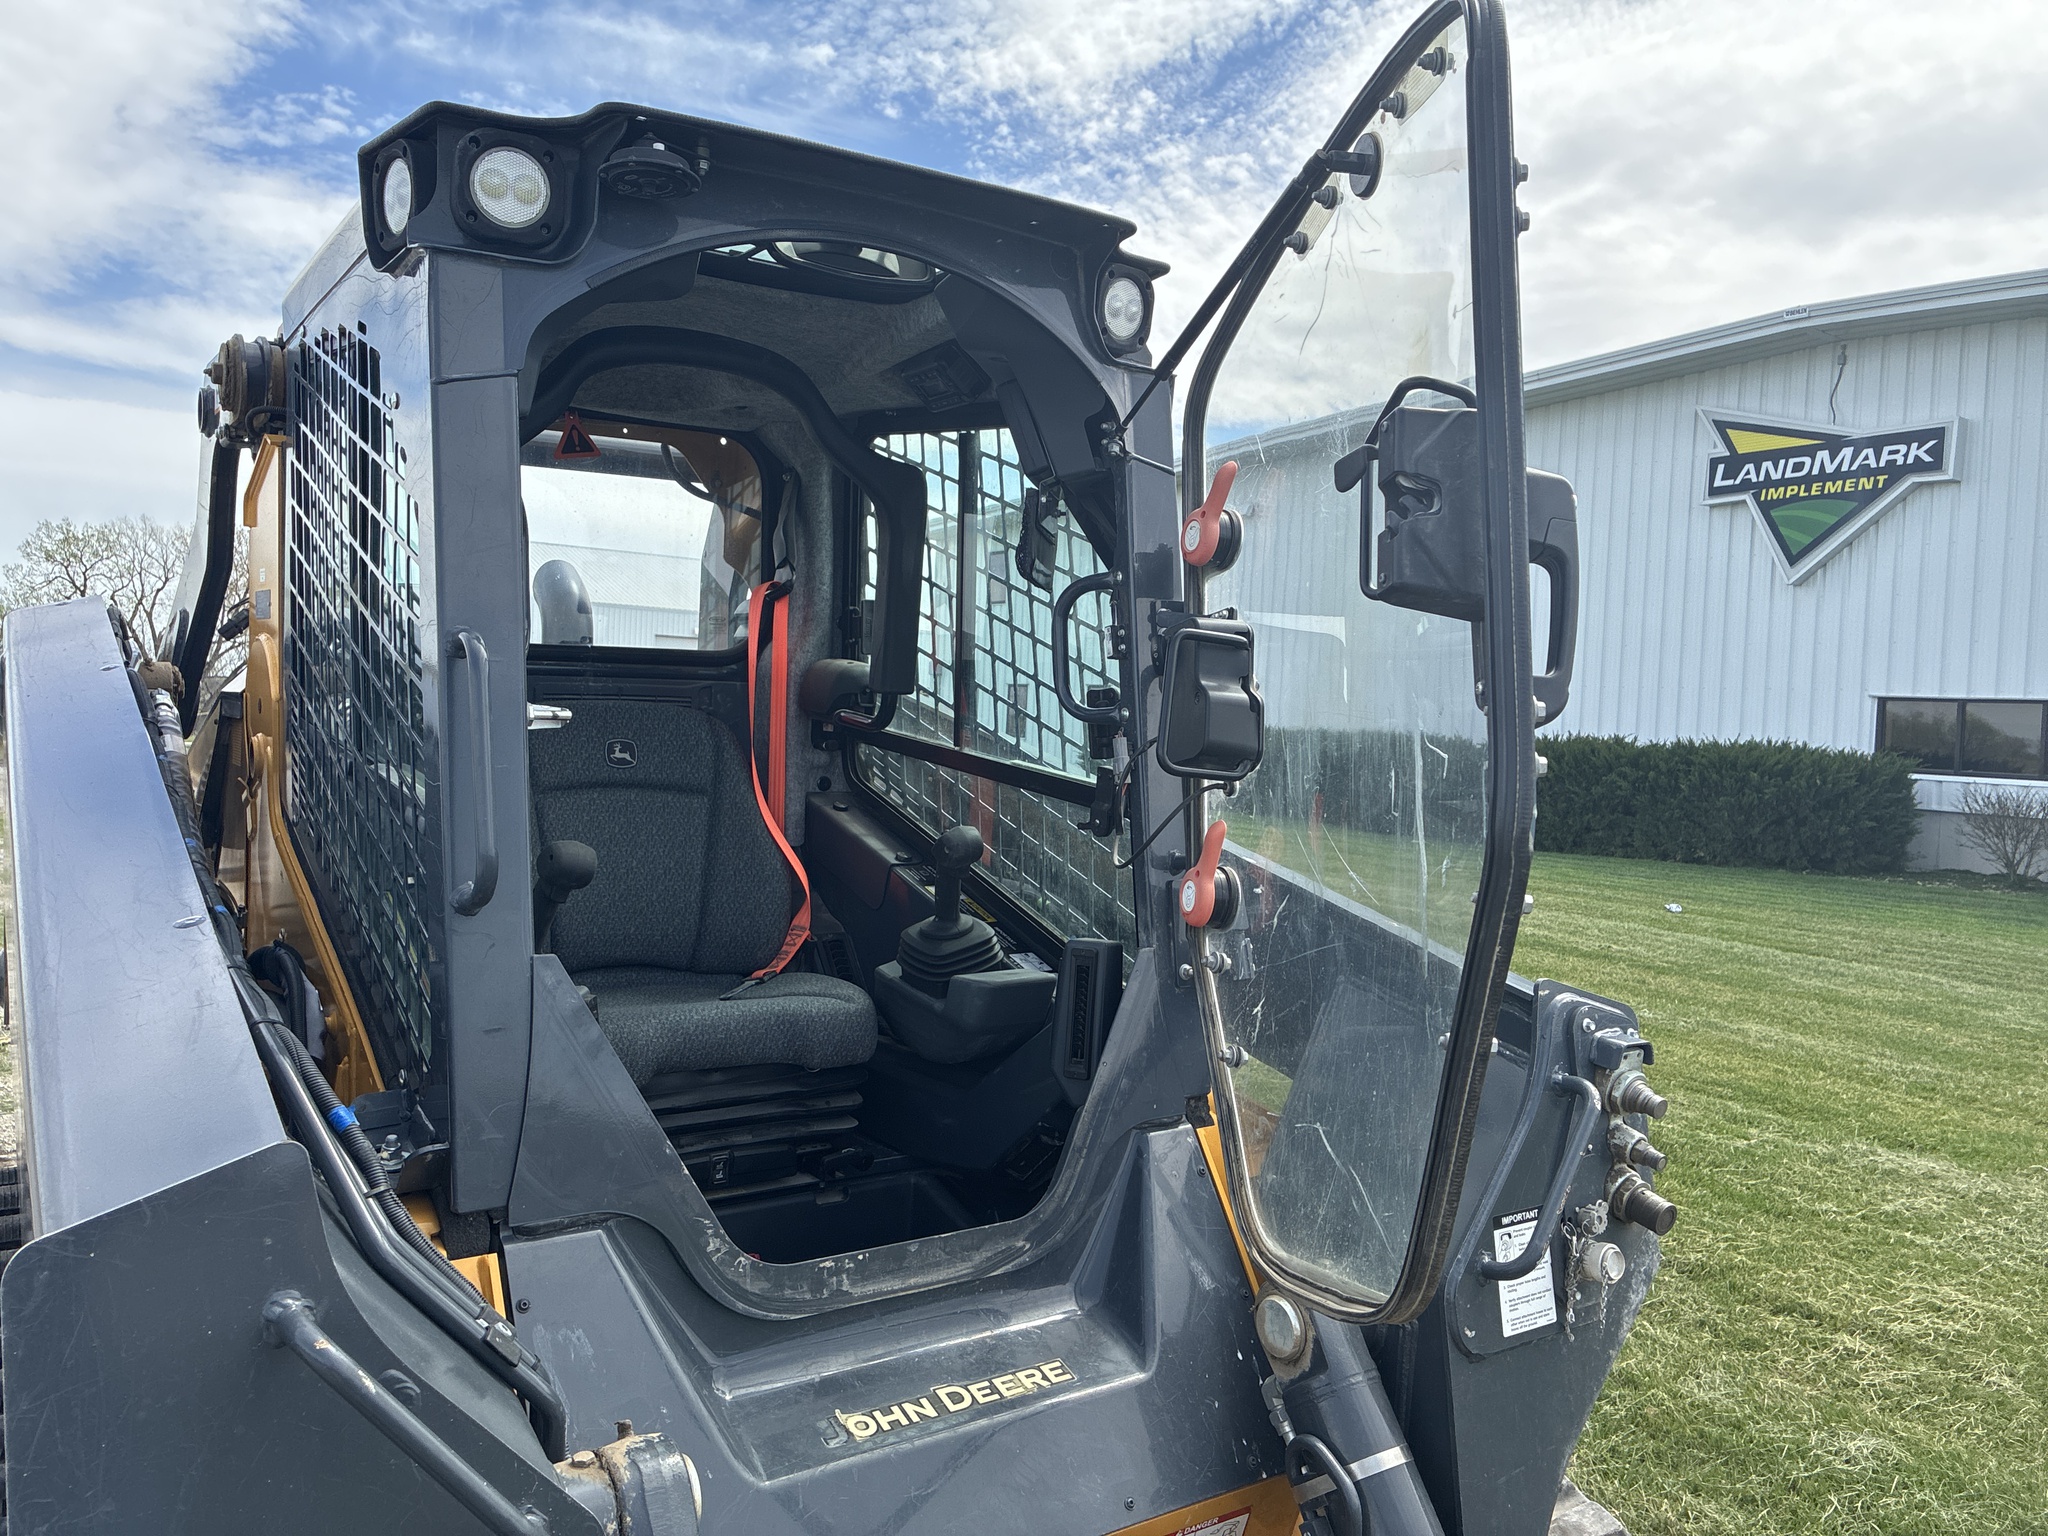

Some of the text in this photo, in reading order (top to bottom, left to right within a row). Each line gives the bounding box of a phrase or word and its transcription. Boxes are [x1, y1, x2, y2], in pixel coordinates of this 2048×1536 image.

[1713, 440, 1939, 487] LANDMARK
[1760, 475, 1888, 501] IMPLEMENT
[1501, 1209, 1538, 1225] IMPORTANT
[938, 1359, 1072, 1413] DEERE
[1185, 1516, 1220, 1535] DANGER
